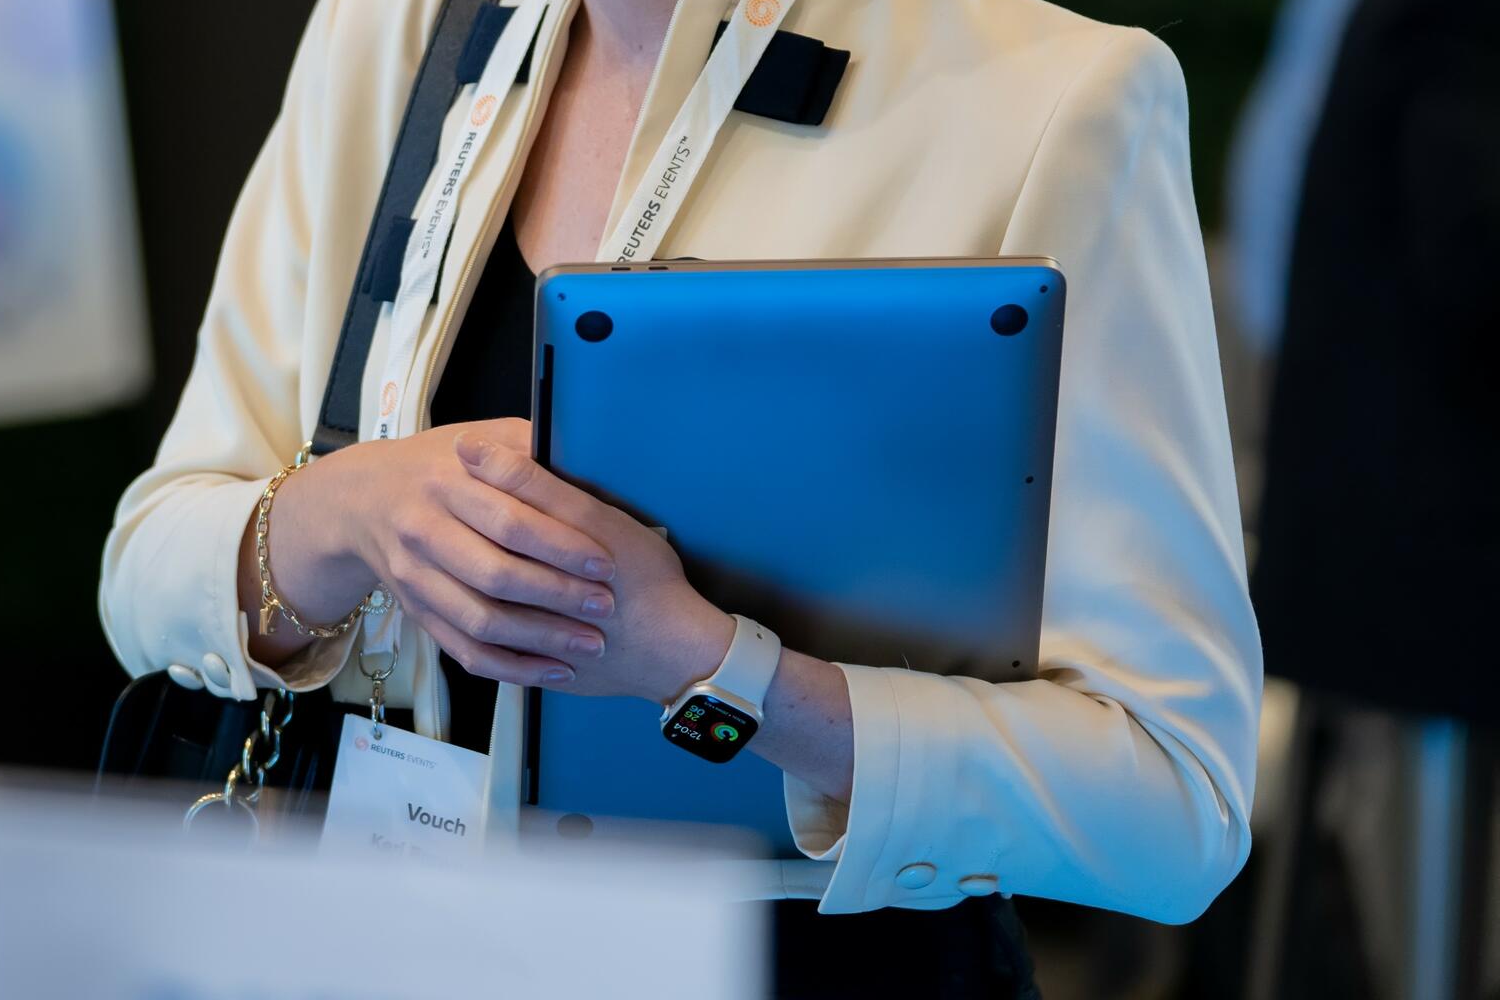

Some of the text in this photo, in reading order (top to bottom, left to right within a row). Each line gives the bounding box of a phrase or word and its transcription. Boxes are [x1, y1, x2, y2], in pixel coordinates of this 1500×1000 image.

[442, 132, 477, 196] REUTERS
[674, 723, 701, 741] 12:04
[371, 743, 405, 760] REUTERS
[407, 803, 466, 836] Vouch
